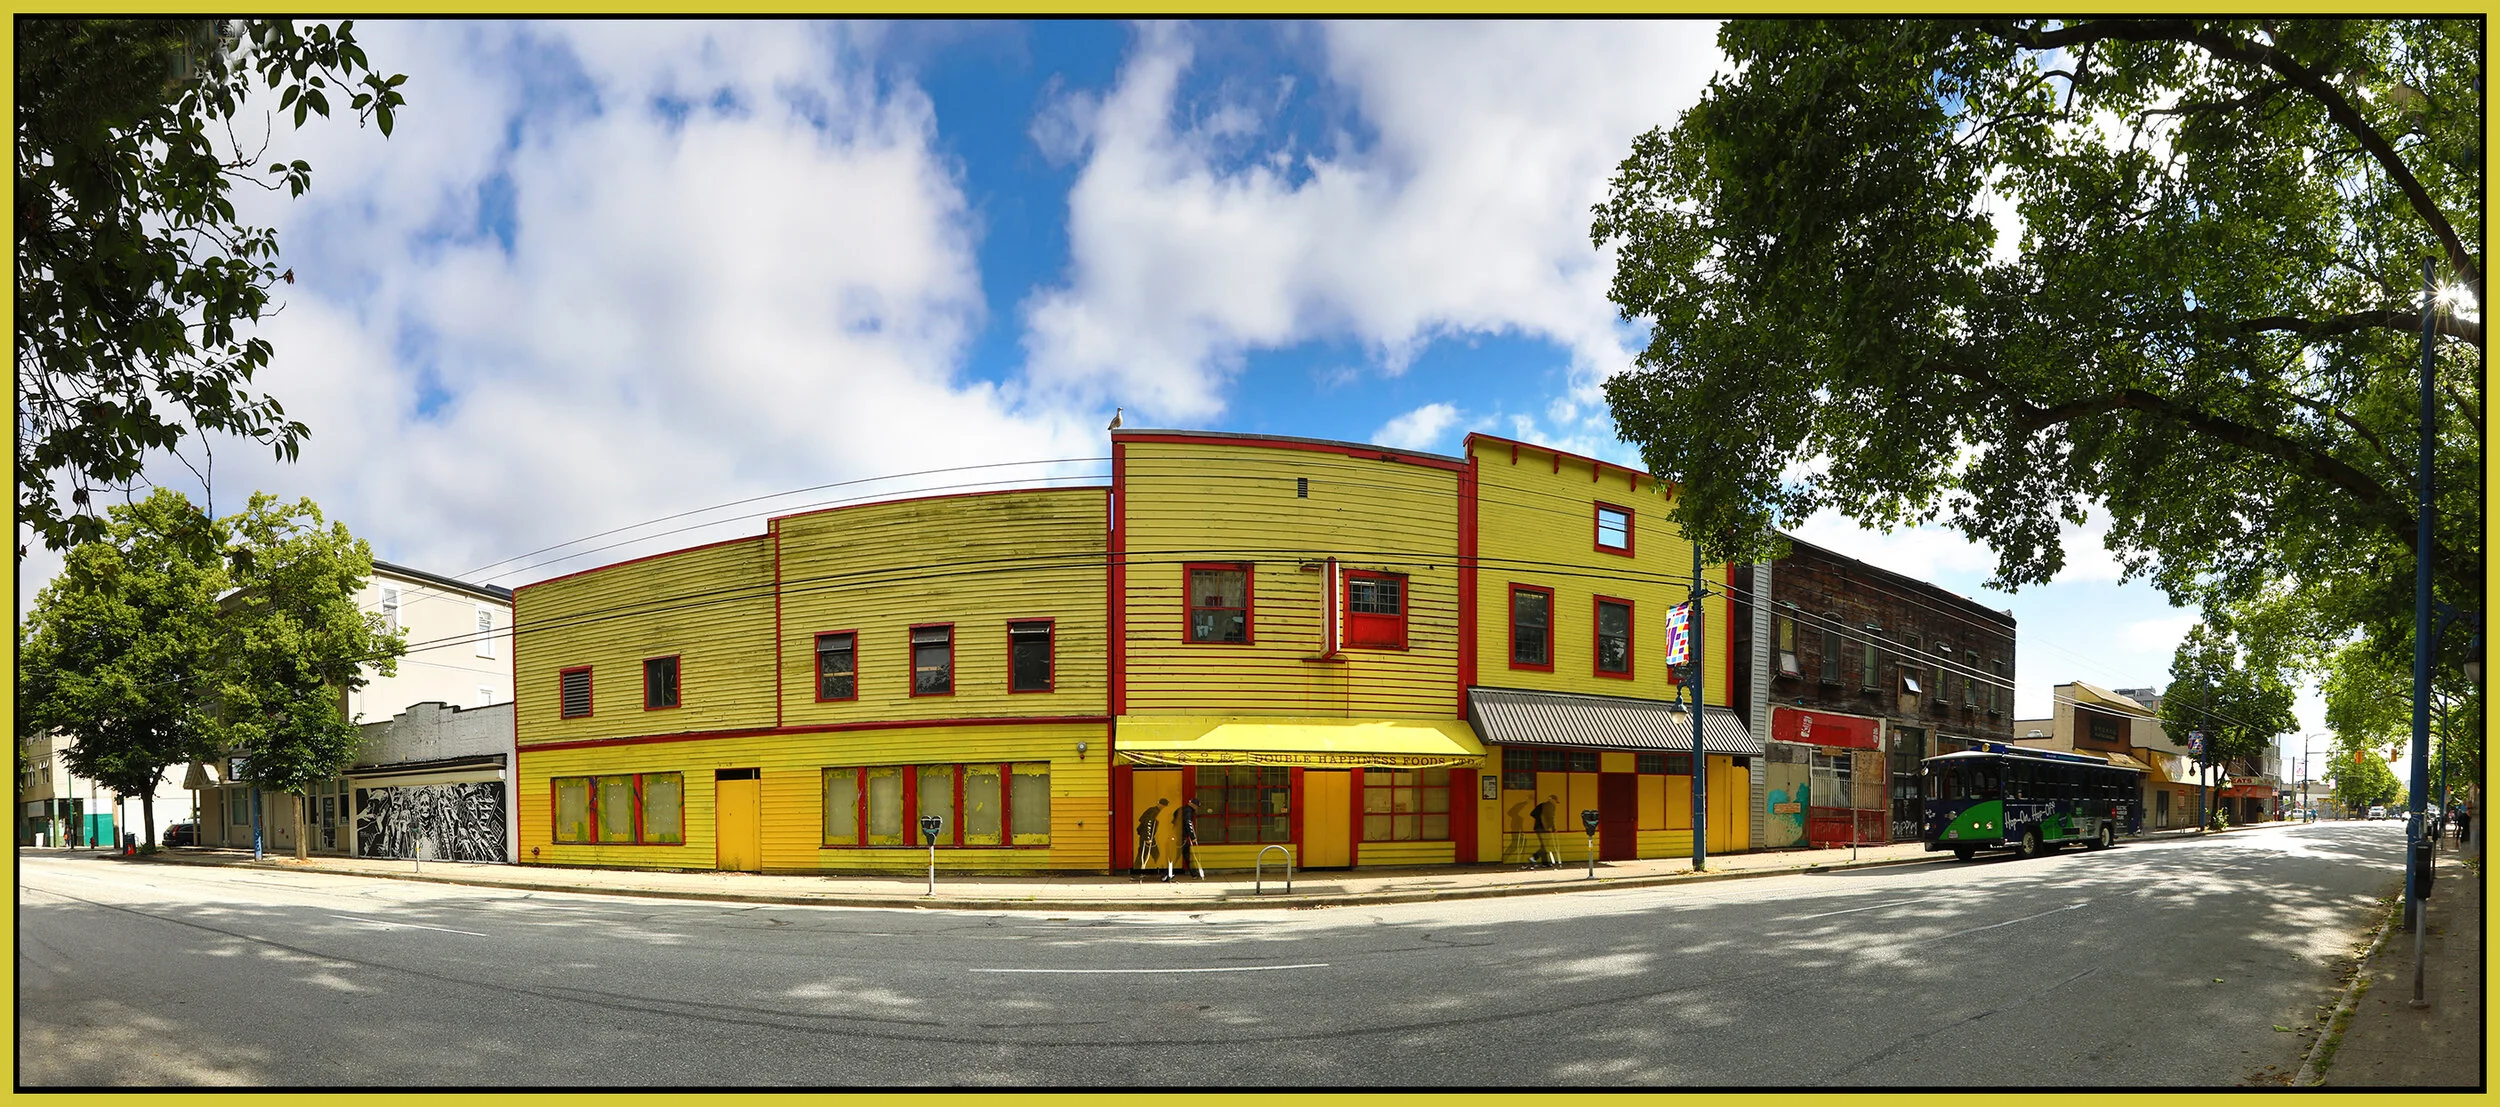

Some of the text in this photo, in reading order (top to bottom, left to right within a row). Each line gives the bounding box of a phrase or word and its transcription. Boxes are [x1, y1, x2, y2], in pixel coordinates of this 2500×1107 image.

[1255, 754, 1312, 763] DOUBLE
[1318, 755, 1397, 765] HAPPINESS
[1402, 756, 1446, 766] FOODS
